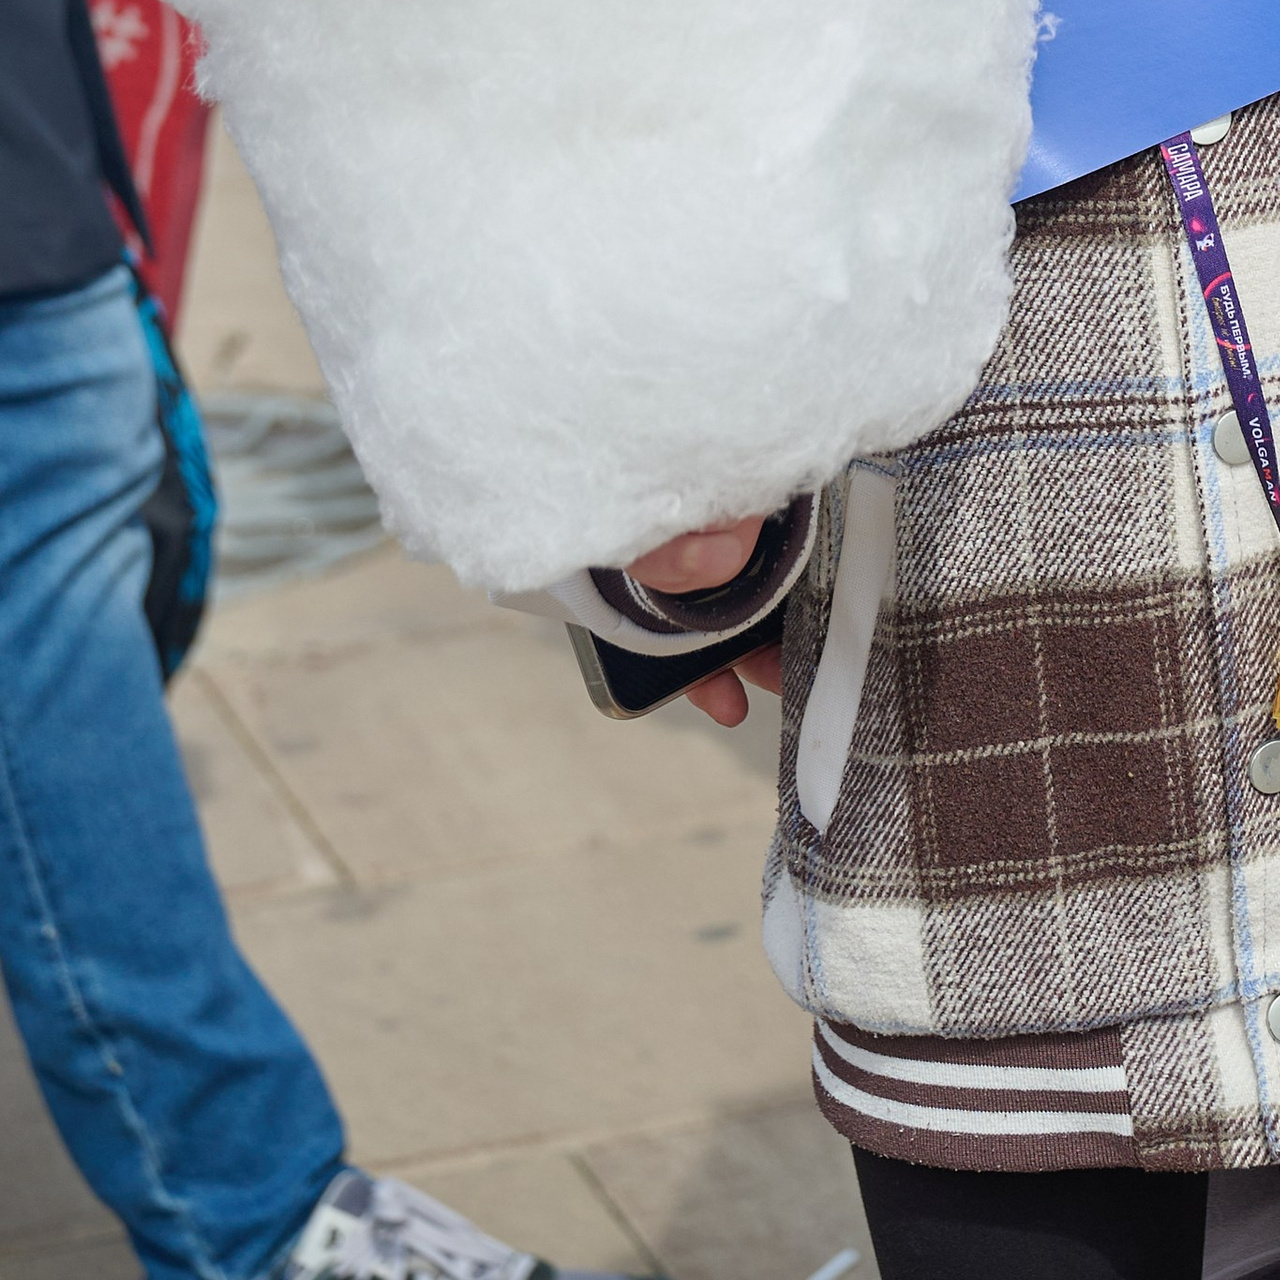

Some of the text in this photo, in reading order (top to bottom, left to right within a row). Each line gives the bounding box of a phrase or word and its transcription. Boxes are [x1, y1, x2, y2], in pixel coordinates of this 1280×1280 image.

[1167, 143, 1203, 202] САМАРА
[1220, 285, 1236, 321] БУДЬ
[1249, 417, 1277, 502] VOLGAMAN
